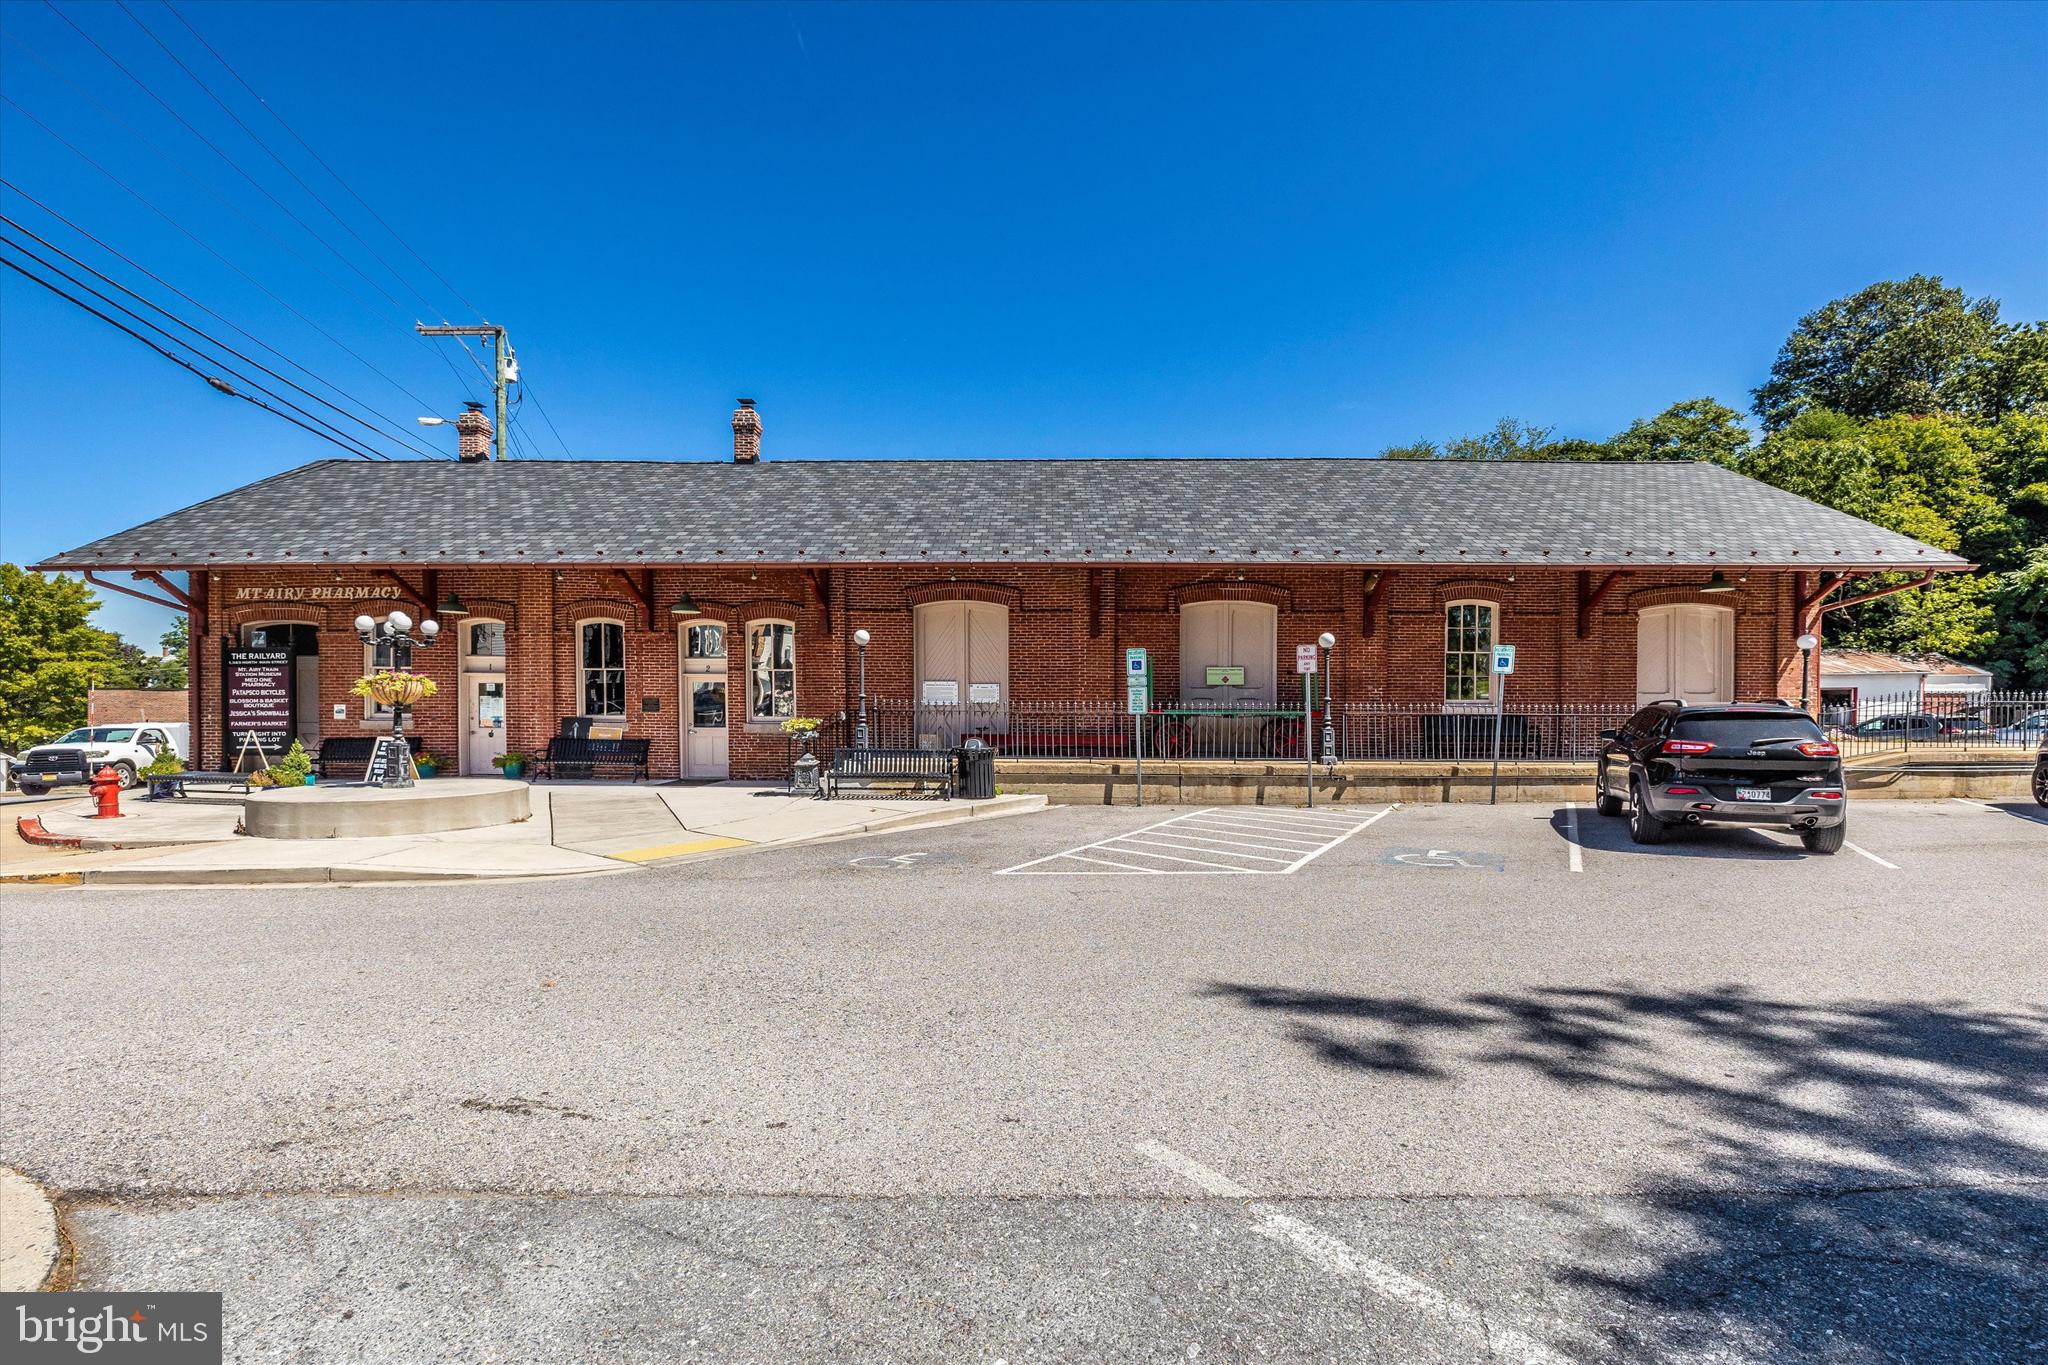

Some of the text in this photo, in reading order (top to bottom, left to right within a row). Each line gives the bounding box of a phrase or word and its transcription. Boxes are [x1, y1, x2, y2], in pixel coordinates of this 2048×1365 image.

[236, 586, 401, 600] MT AIRY PHARMACY
